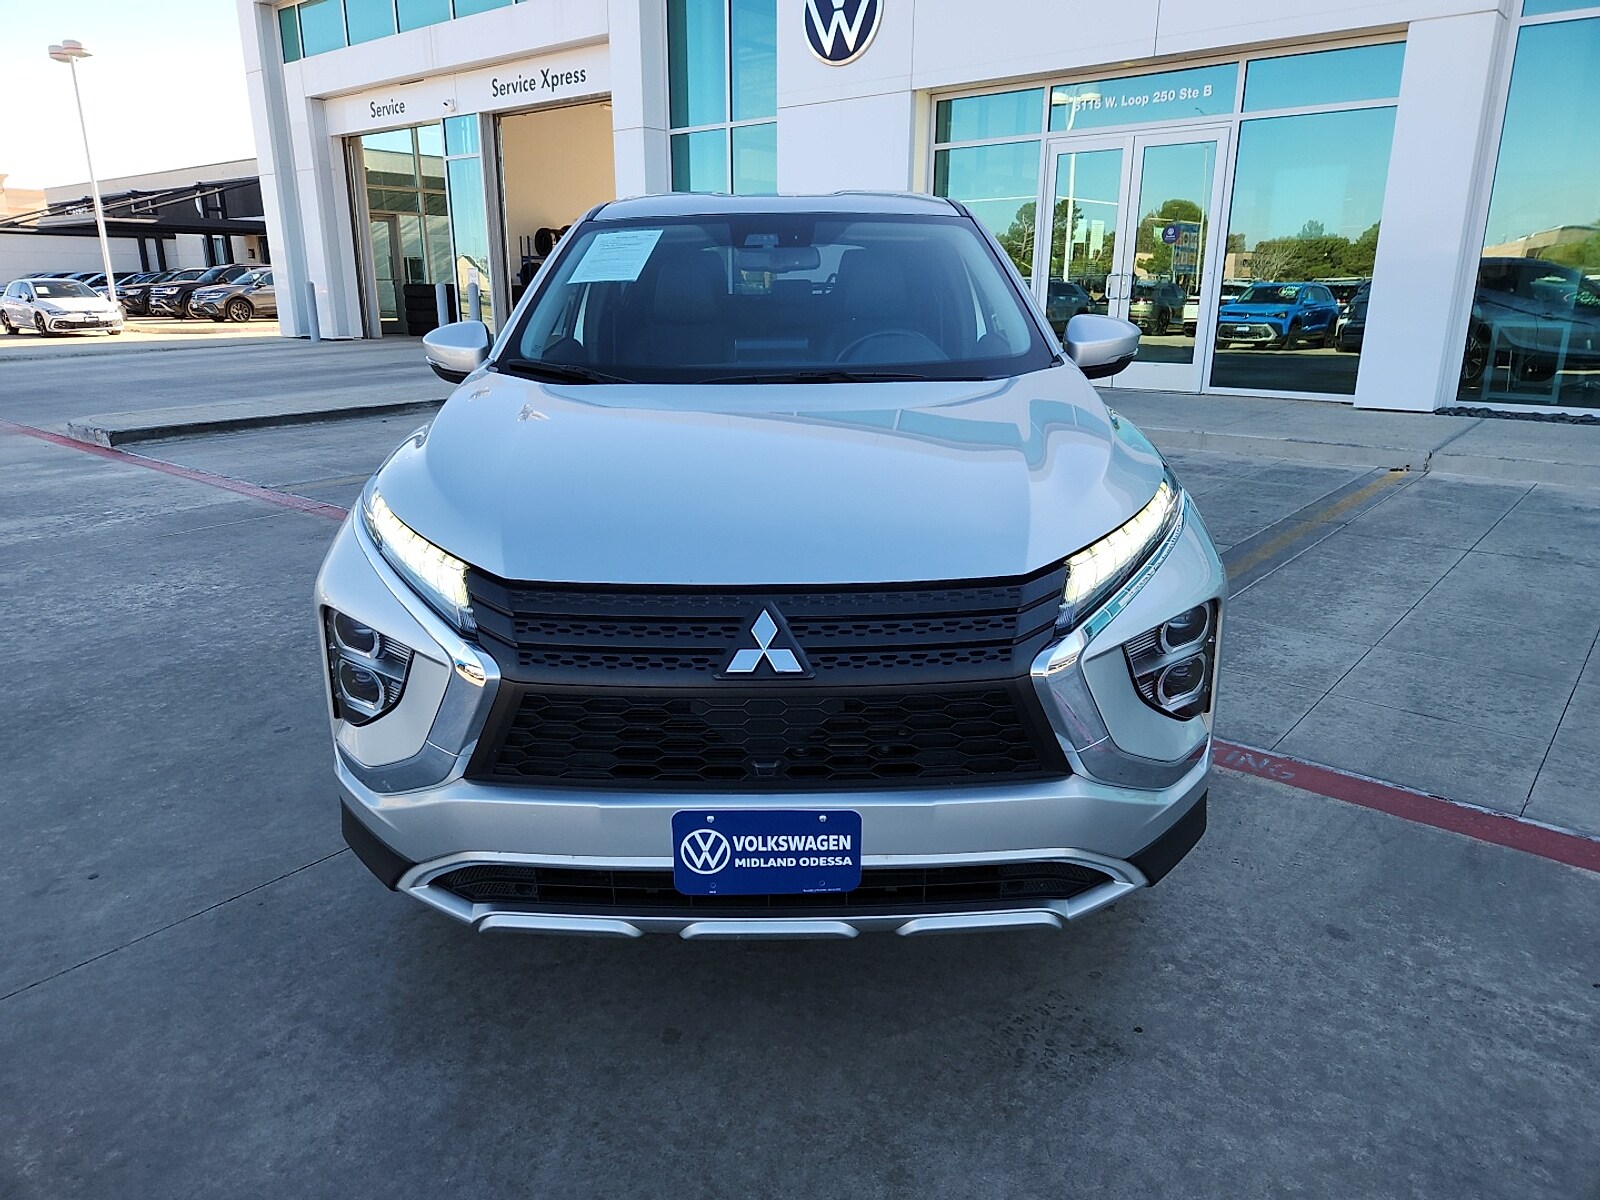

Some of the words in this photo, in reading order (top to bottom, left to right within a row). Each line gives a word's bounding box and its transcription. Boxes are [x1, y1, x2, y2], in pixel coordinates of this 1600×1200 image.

[491, 74, 537, 98] Service
[540, 68, 587, 93] Xpress
[1105, 96, 1118, 108] W.
[1121, 94, 1149, 107] Loop
[1152, 90, 1176, 103] 250
[1179, 87, 1200, 101] Ste
[1203, 84, 1213, 97] B
[369, 98, 406, 119] Service
[732, 834, 852, 852] VOLKSWAGEN
[734, 857, 797, 868] MIDLAND
[799, 856, 853, 867] ODESSA
